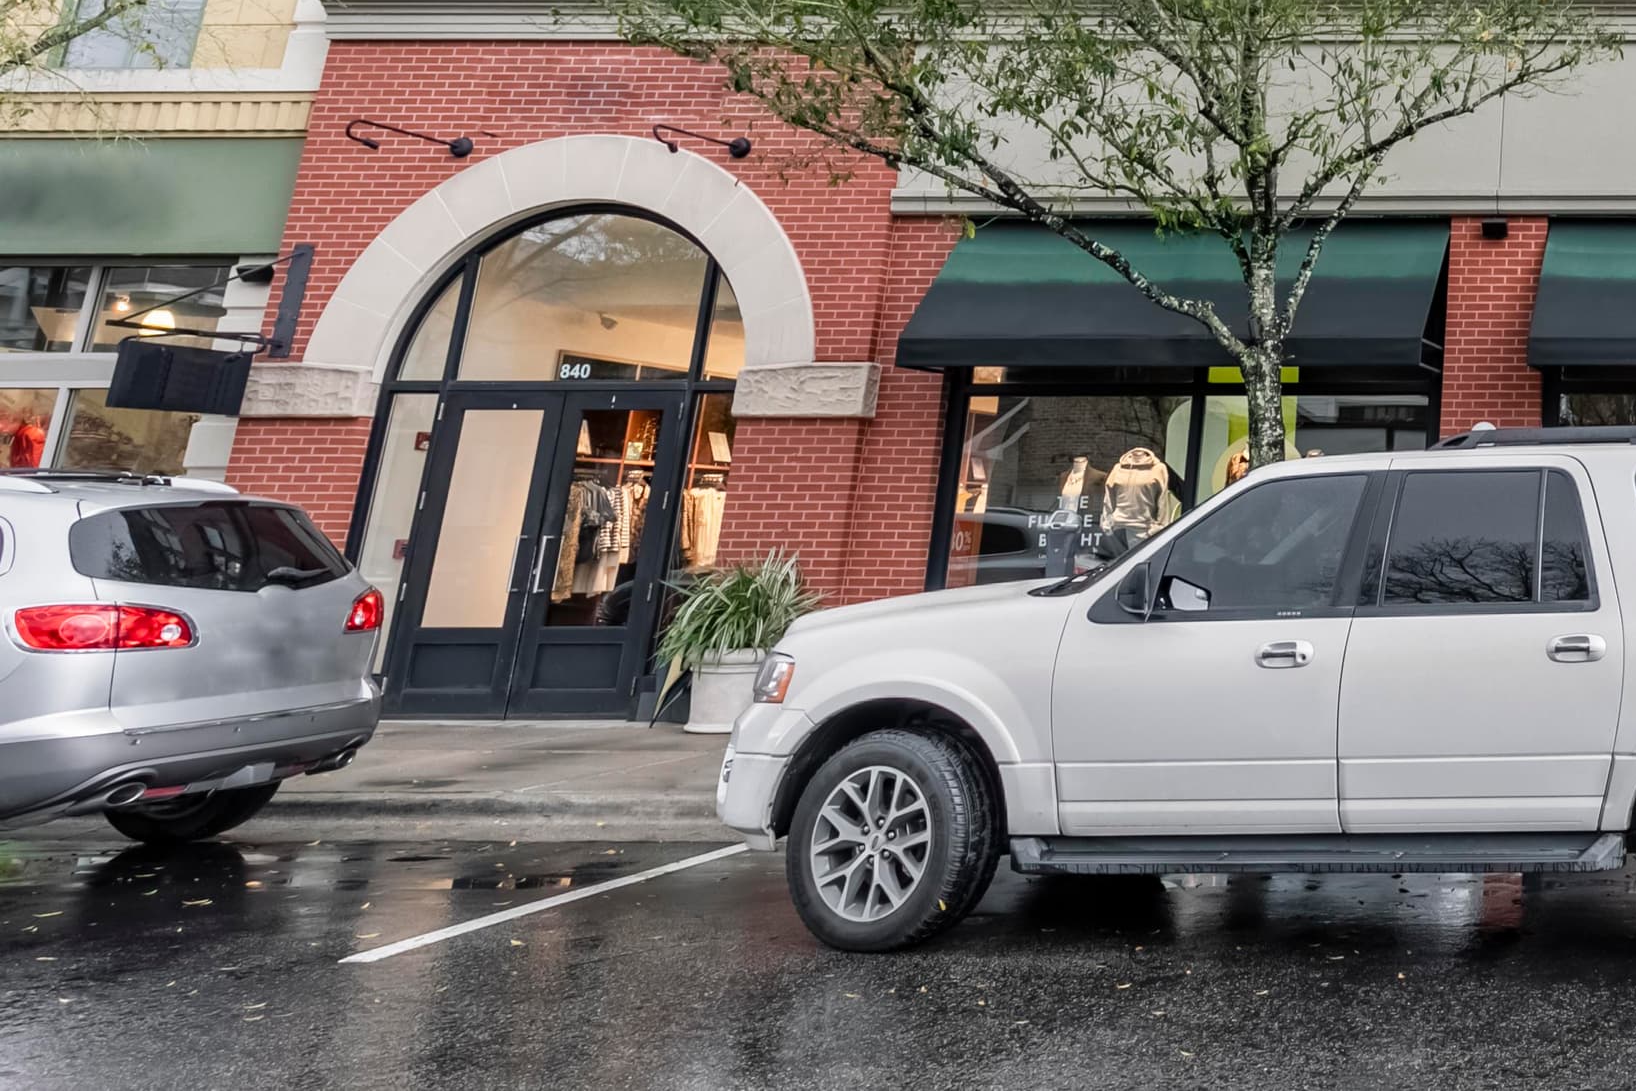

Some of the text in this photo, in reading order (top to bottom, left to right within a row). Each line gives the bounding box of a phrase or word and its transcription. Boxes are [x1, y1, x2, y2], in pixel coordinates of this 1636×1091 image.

[560, 363, 591, 379] 840
[1057, 495, 1089, 509] TE
[1028, 514, 1093, 528] FUE
